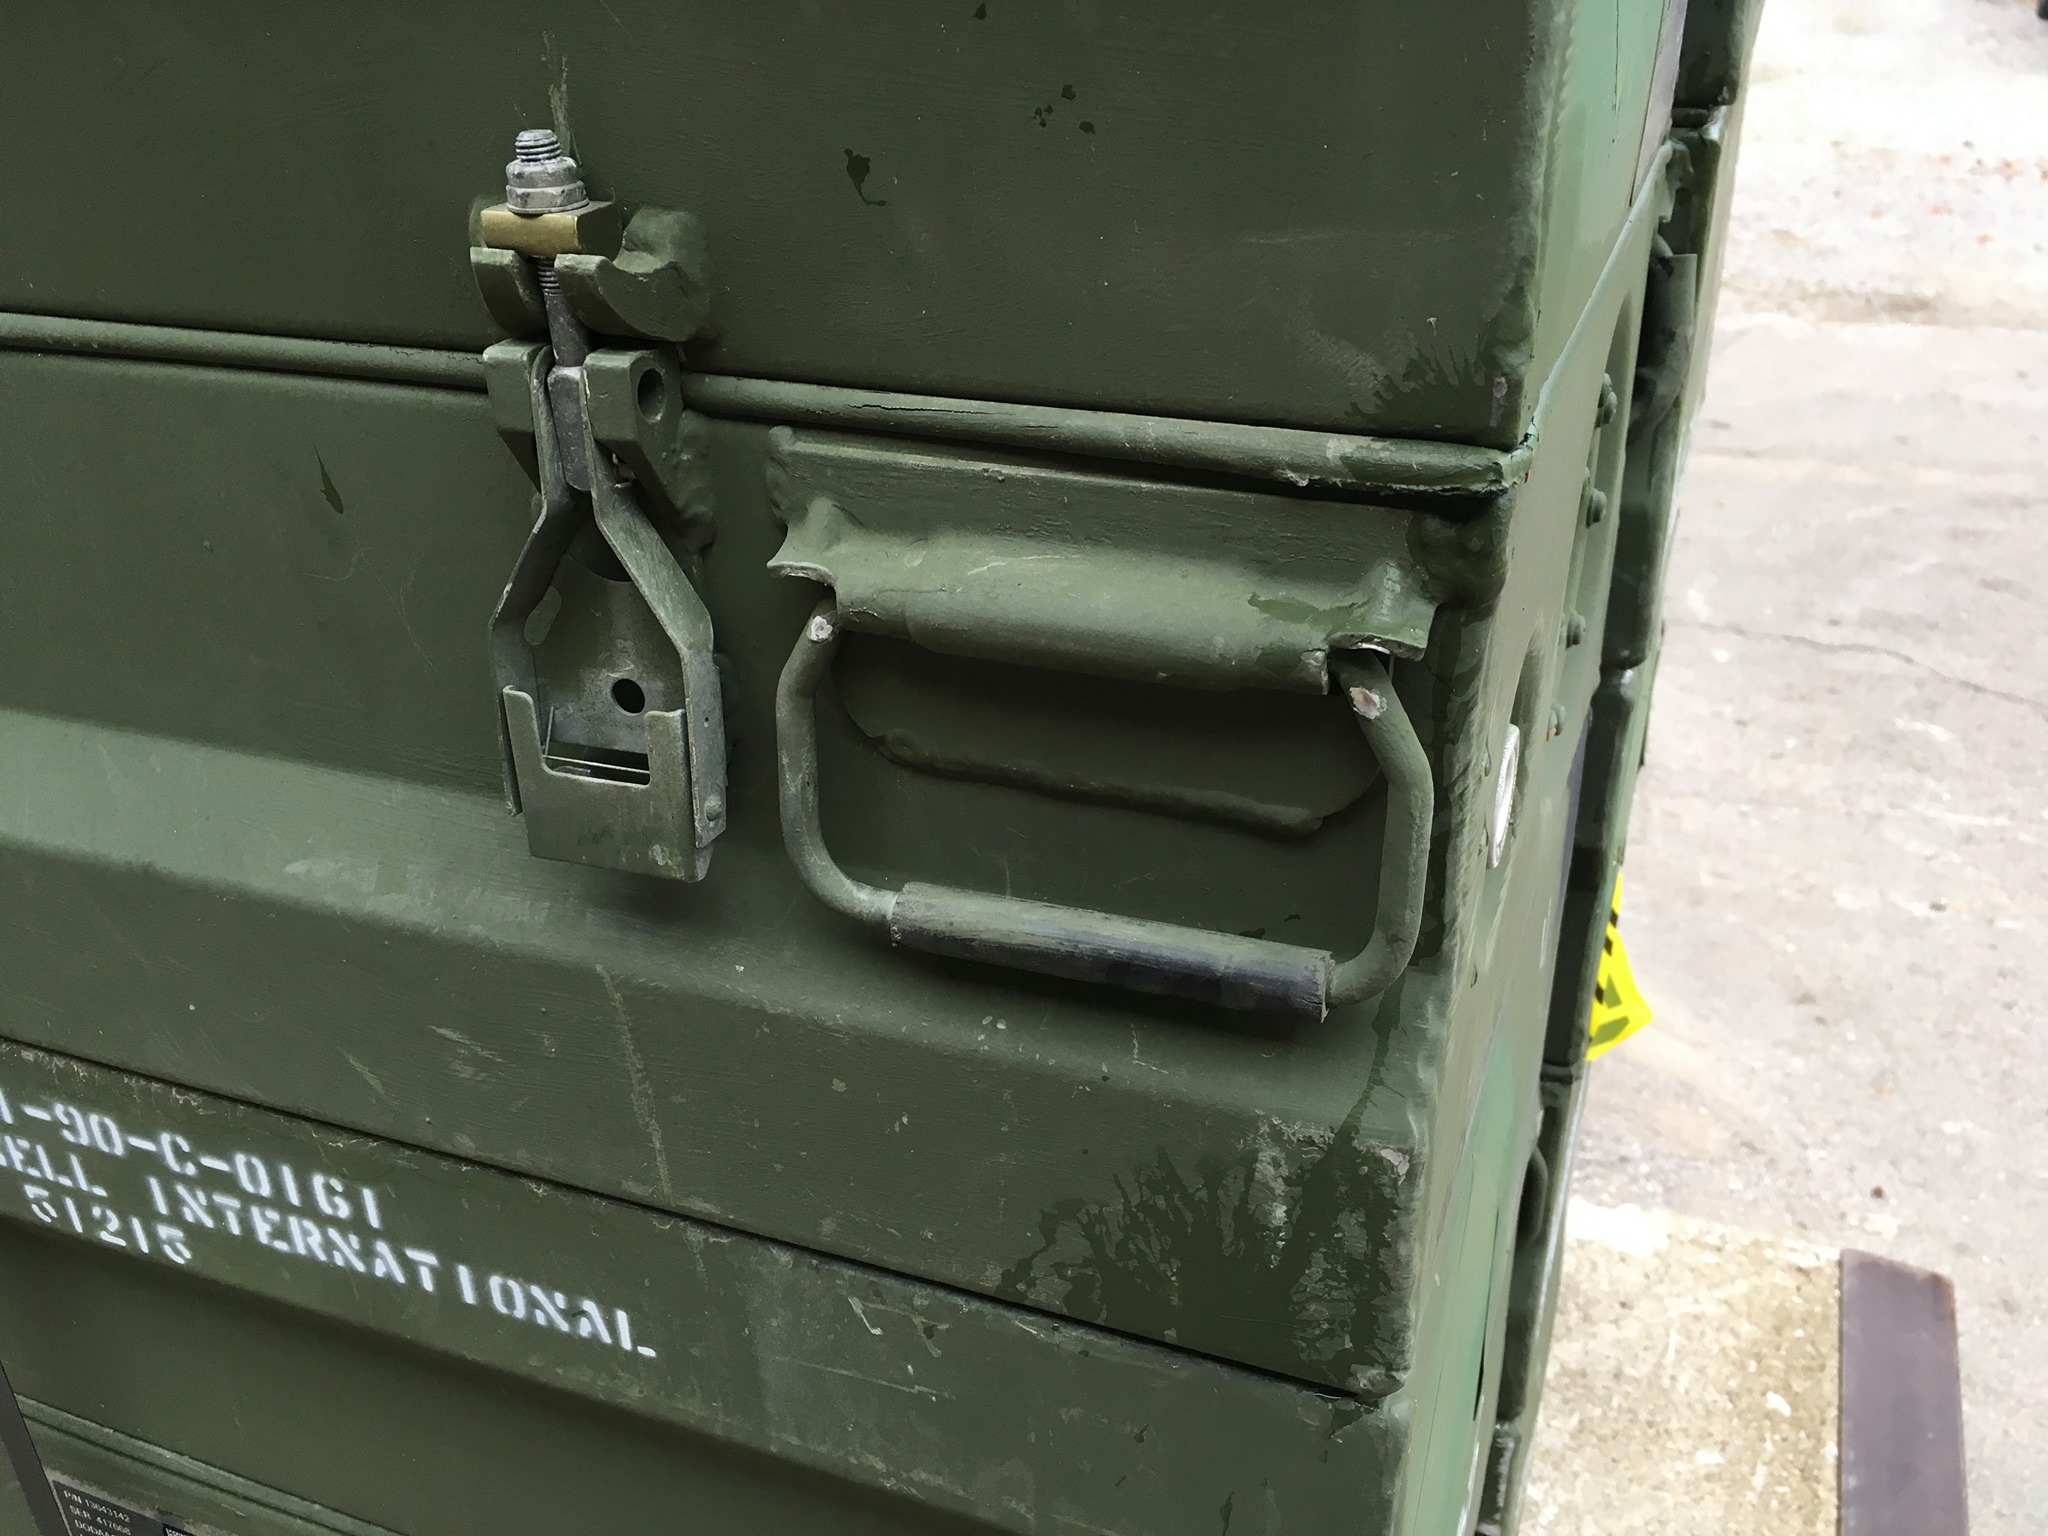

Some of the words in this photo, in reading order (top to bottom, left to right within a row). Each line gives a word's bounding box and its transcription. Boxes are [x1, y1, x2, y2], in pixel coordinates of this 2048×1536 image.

[0, 1135, 108, 1198] ELL
[149, 1176, 656, 1358] INTERNATIONAL
[23, 1184, 192, 1264] 51215
